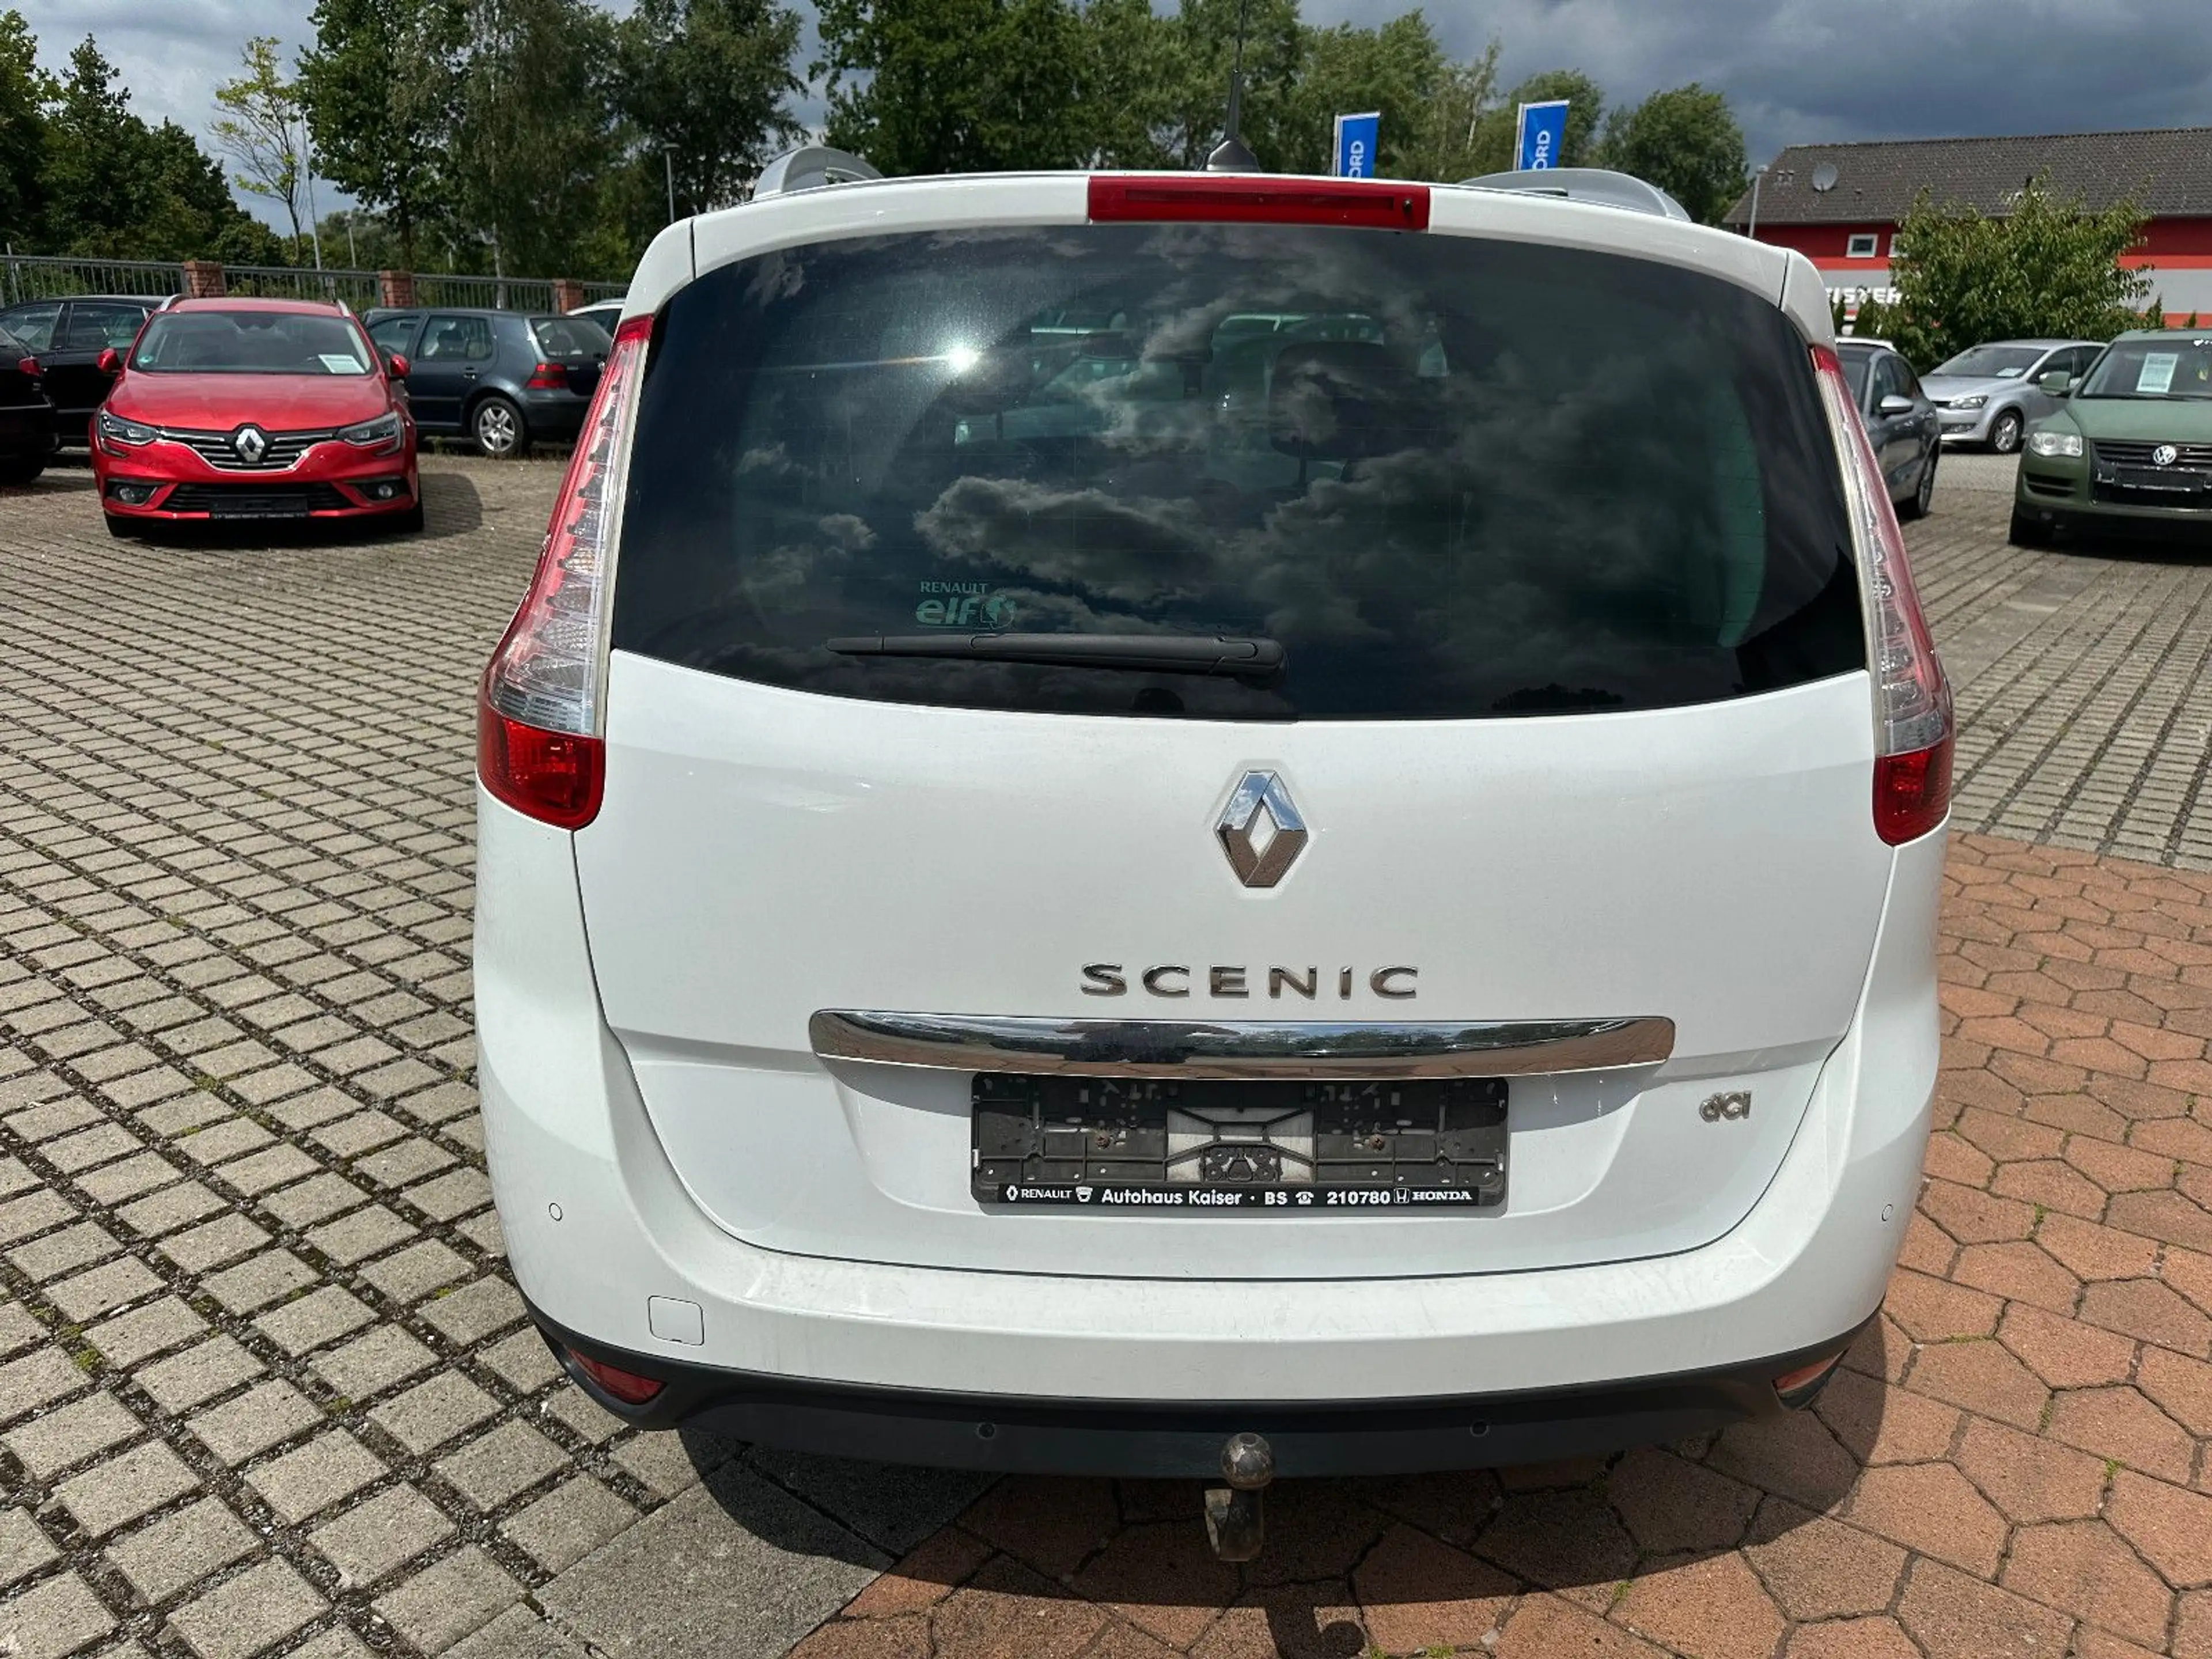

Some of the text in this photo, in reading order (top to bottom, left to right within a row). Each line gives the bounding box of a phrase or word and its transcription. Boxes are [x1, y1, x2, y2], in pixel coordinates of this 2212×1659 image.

[920, 581, 988, 594] RENAULT
[1081, 963, 1418, 999] SCENIC
[1021, 1188, 1472, 1205] RENAULT Autohaus Kaiser BS 210780 HONDA
